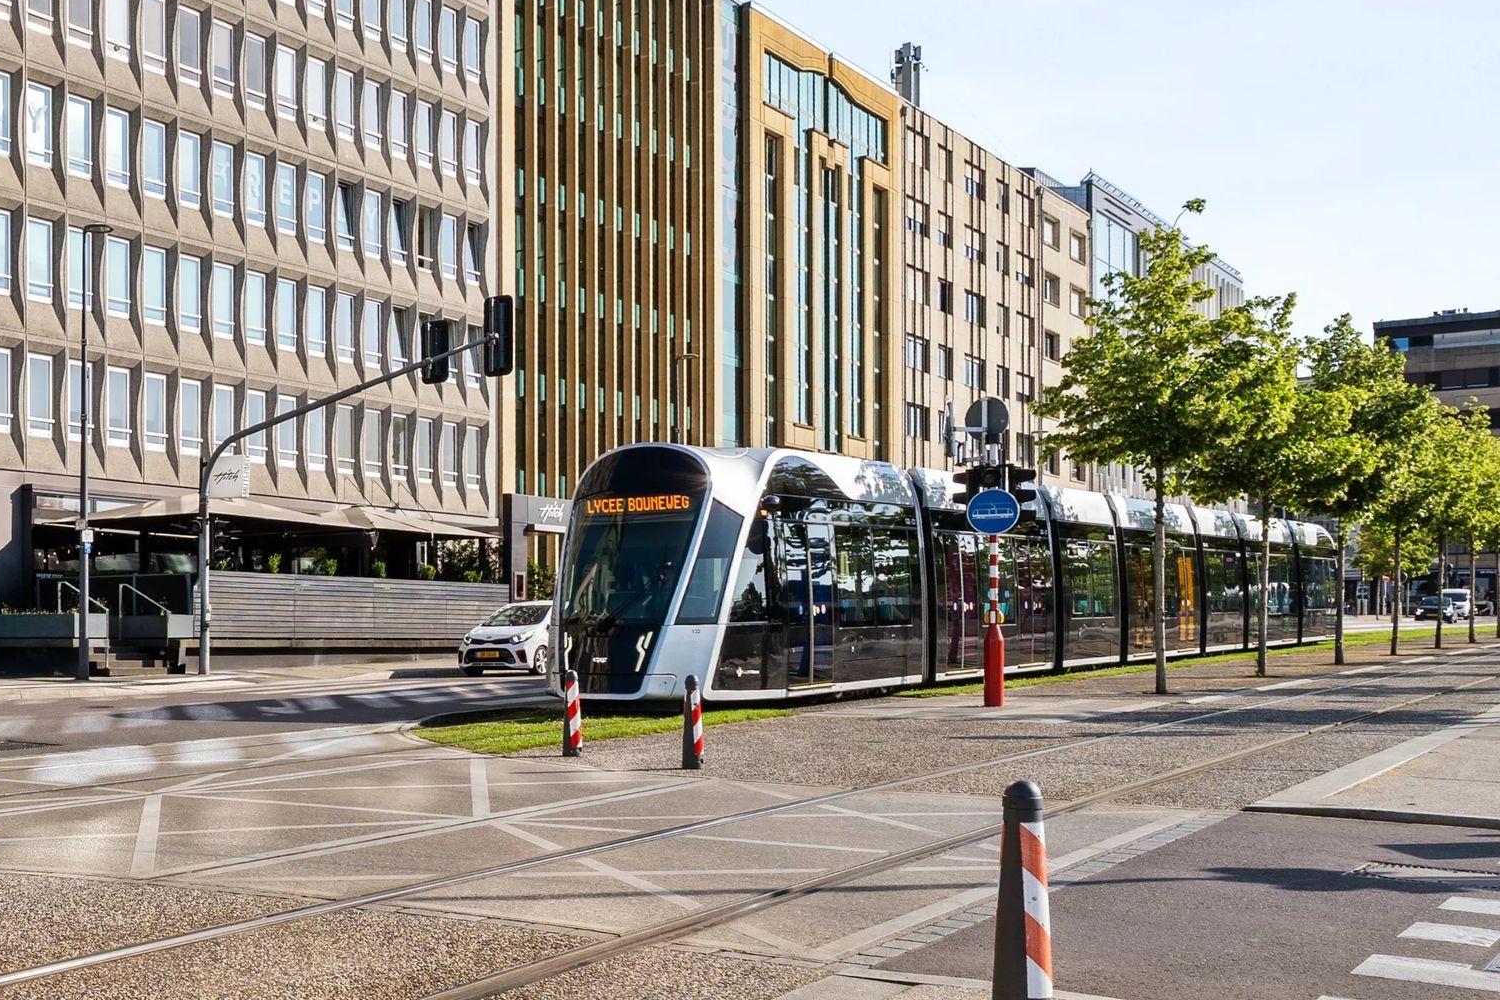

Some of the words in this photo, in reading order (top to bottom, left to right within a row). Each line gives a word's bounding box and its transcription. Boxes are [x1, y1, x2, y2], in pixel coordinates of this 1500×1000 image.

[539, 500, 565, 523] Hitch
[587, 498, 624, 514] LYCEE
[627, 494, 690, 512] BOUNEWEG
